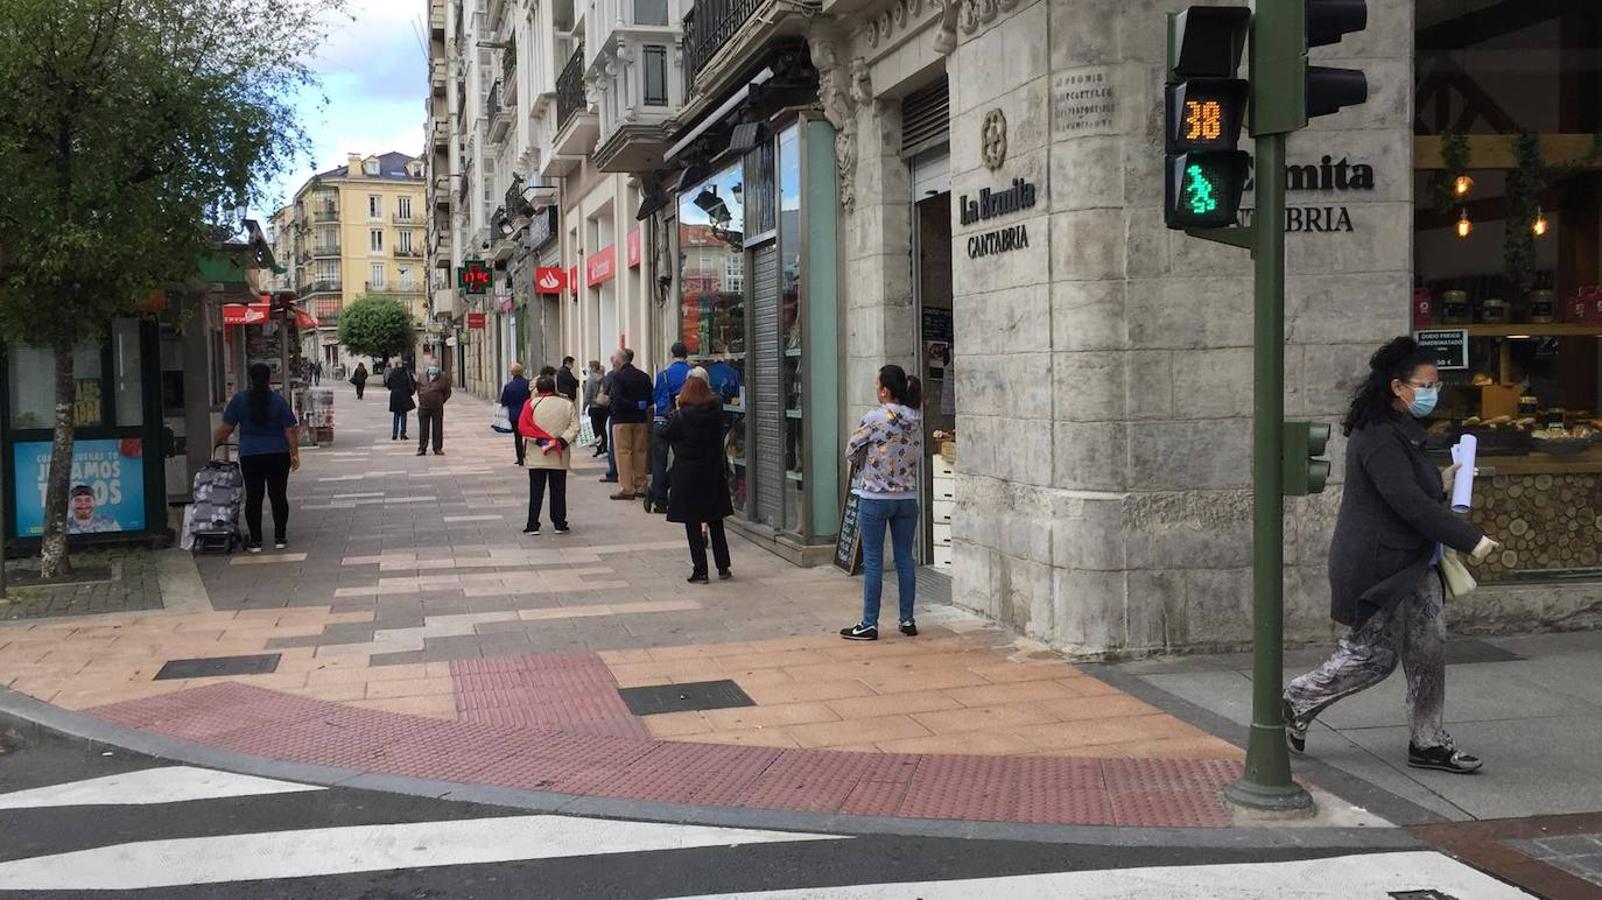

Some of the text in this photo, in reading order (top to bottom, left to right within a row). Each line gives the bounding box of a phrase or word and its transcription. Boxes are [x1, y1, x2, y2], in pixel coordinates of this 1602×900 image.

[1186, 101, 1220, 139] 38
[1242, 154, 1375, 190] mita
[959, 177, 1036, 226] La Ermita
[967, 224, 1030, 260] CANTABRIA
[38, 460, 121, 481] JAMOS
[38, 479, 122, 509] TOS
